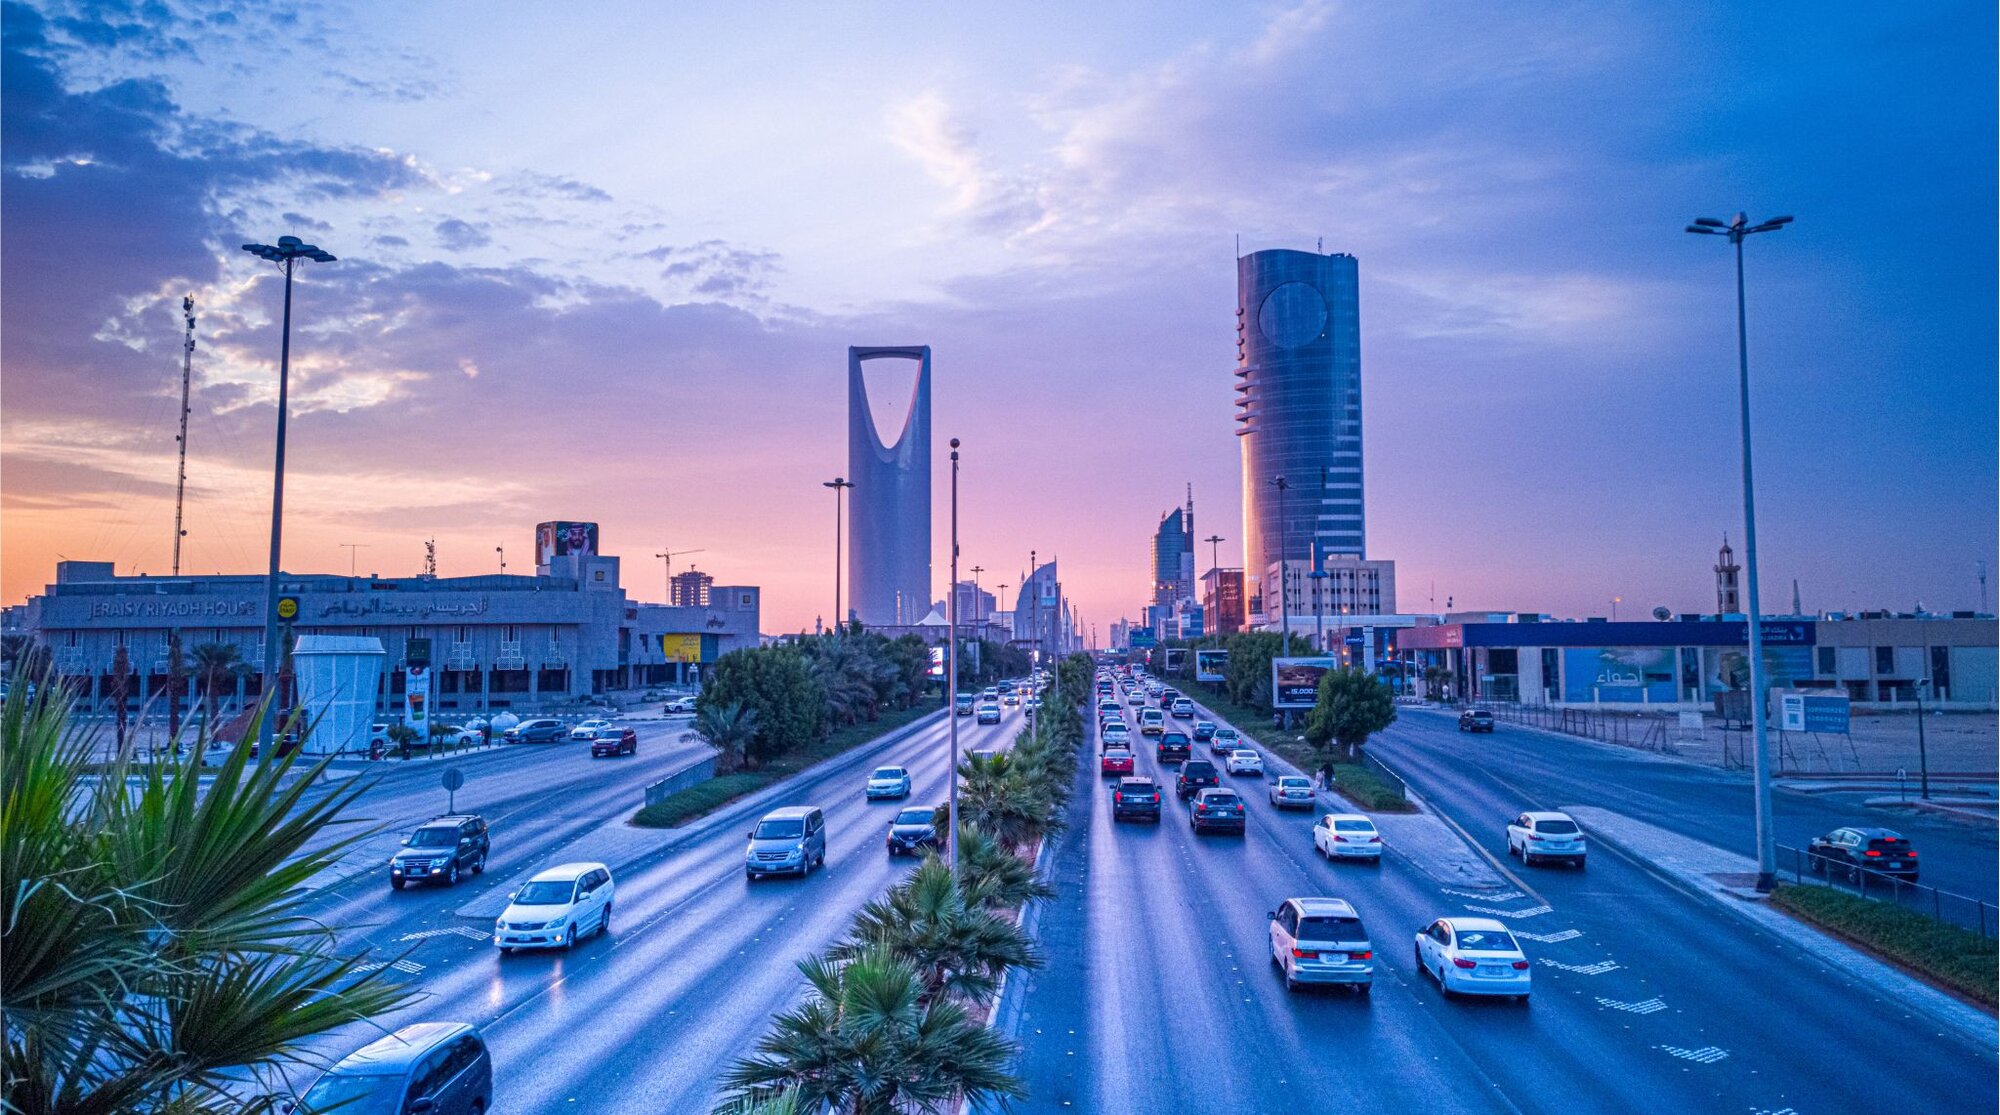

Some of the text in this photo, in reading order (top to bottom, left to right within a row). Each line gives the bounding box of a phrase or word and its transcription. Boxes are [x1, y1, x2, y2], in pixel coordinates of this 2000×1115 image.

[87, 601, 257, 621] JERAISY RIYADH HOUSE
[1291, 688, 1314, 696] 15,000
